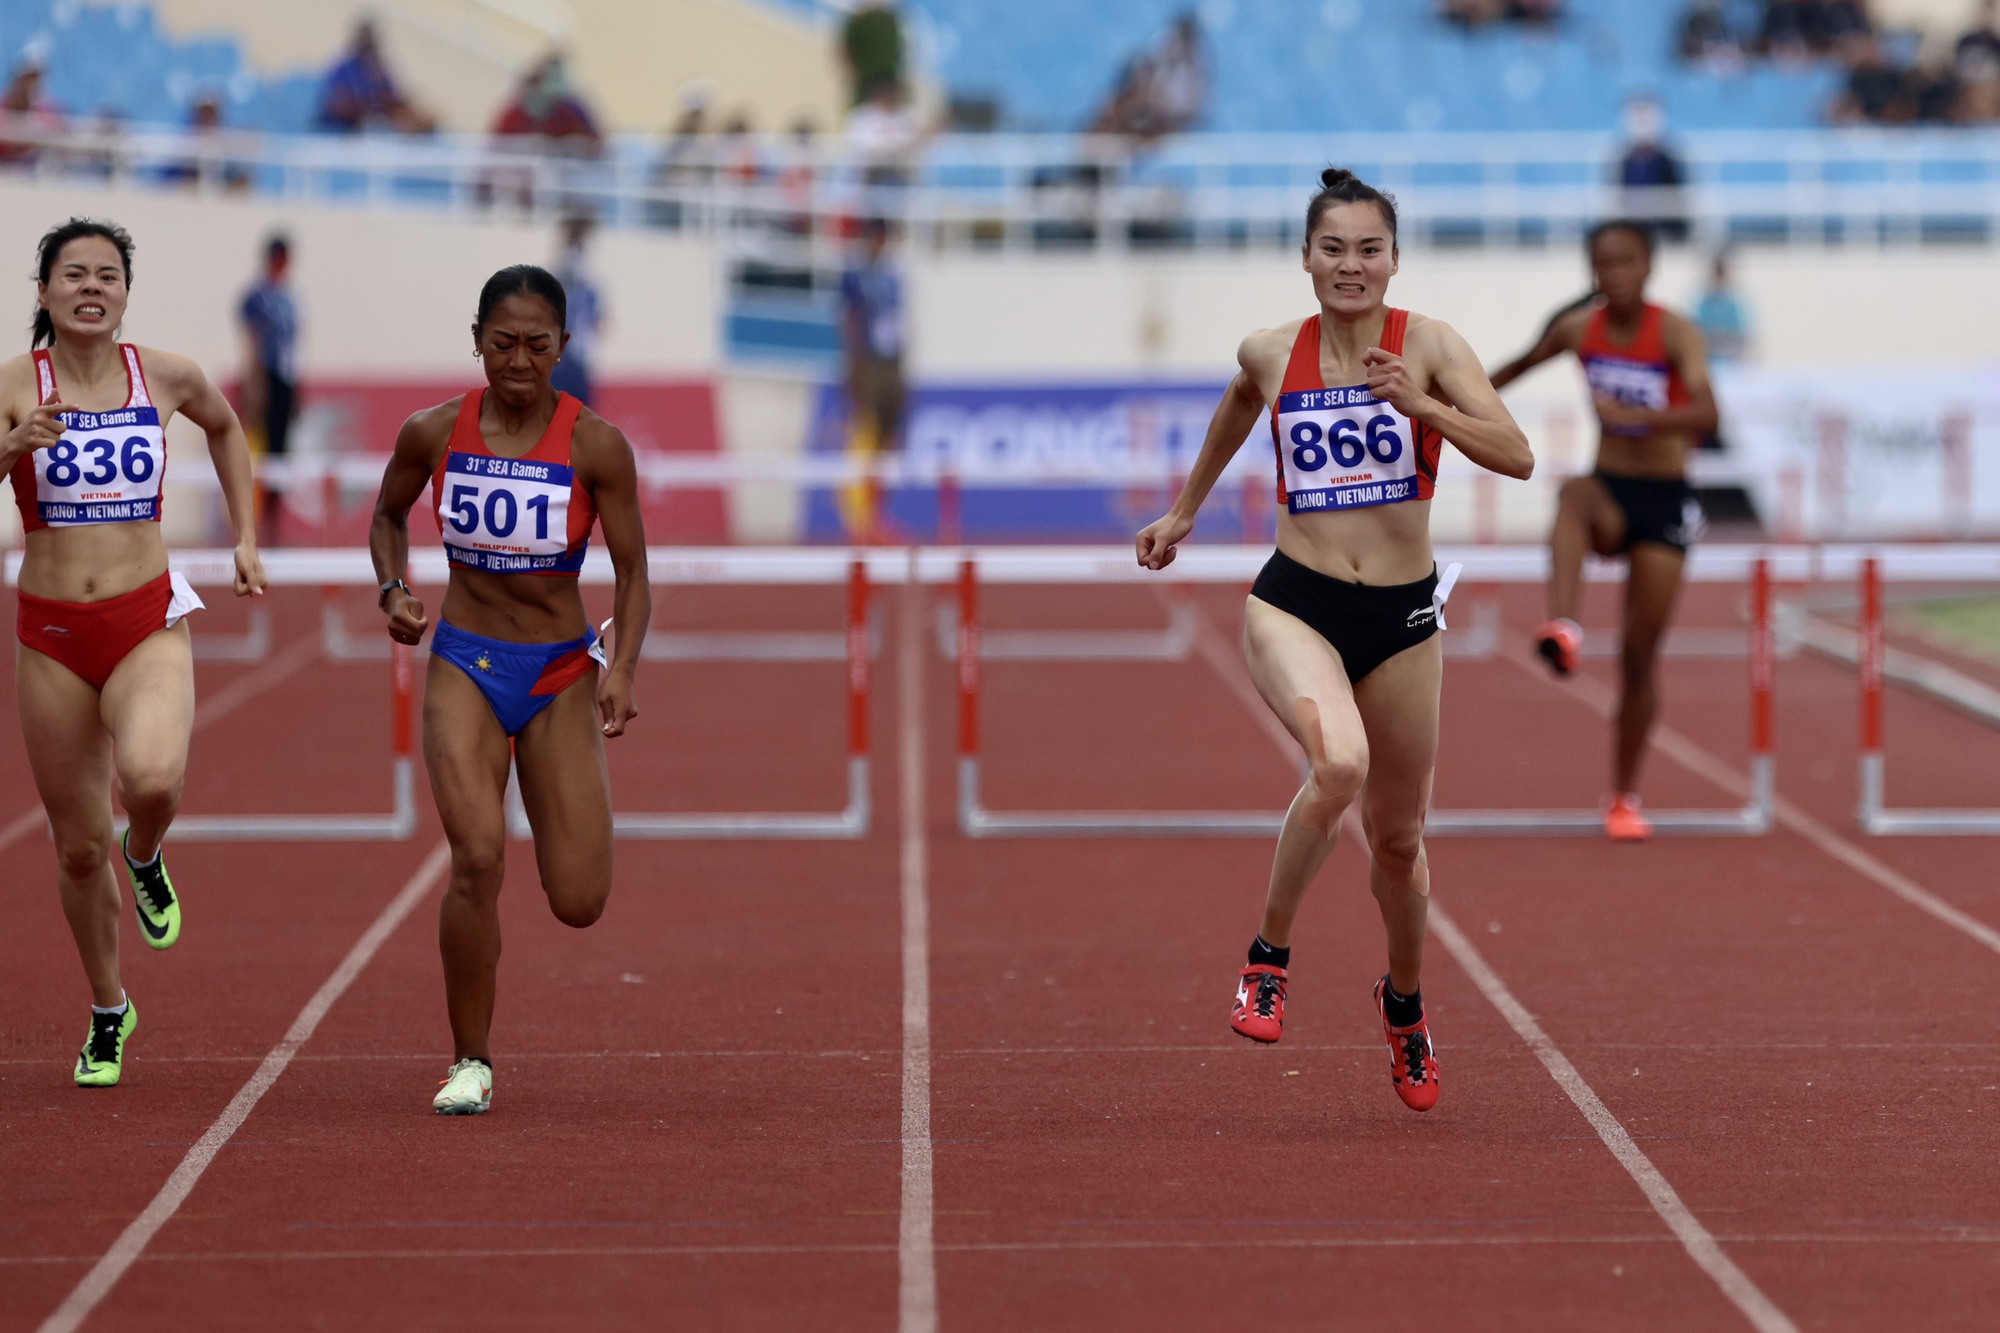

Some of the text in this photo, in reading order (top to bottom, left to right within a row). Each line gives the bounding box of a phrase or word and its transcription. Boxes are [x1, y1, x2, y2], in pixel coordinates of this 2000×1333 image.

[1324, 390, 1345, 406] SEA
[1348, 389, 1378, 404] Gam
[78, 413, 98, 429] SEA
[100, 411, 137, 425] Games
[1290, 414, 1403, 472] 866
[46, 436, 154, 487] 836
[487, 459, 508, 476] SEA
[511, 462, 549, 480] Games
[1330, 473, 1372, 485] VIETNAM
[80, 492, 122, 500] VIETNAM
[1295, 492, 1327, 509] HANOI
[1335, 485, 1383, 505] VIETNAM
[1385, 482, 1410, 499] 2022
[45, 505, 76, 519] HANOI
[86, 503, 131, 519] VIETNAM
[132, 502, 152, 517] 2022
[448, 484, 549, 540] 501
[472, 542, 530, 553] PHILIPPINES
[451, 548, 479, 566] HANOI
[487, 554, 531, 570] VIETNAM
